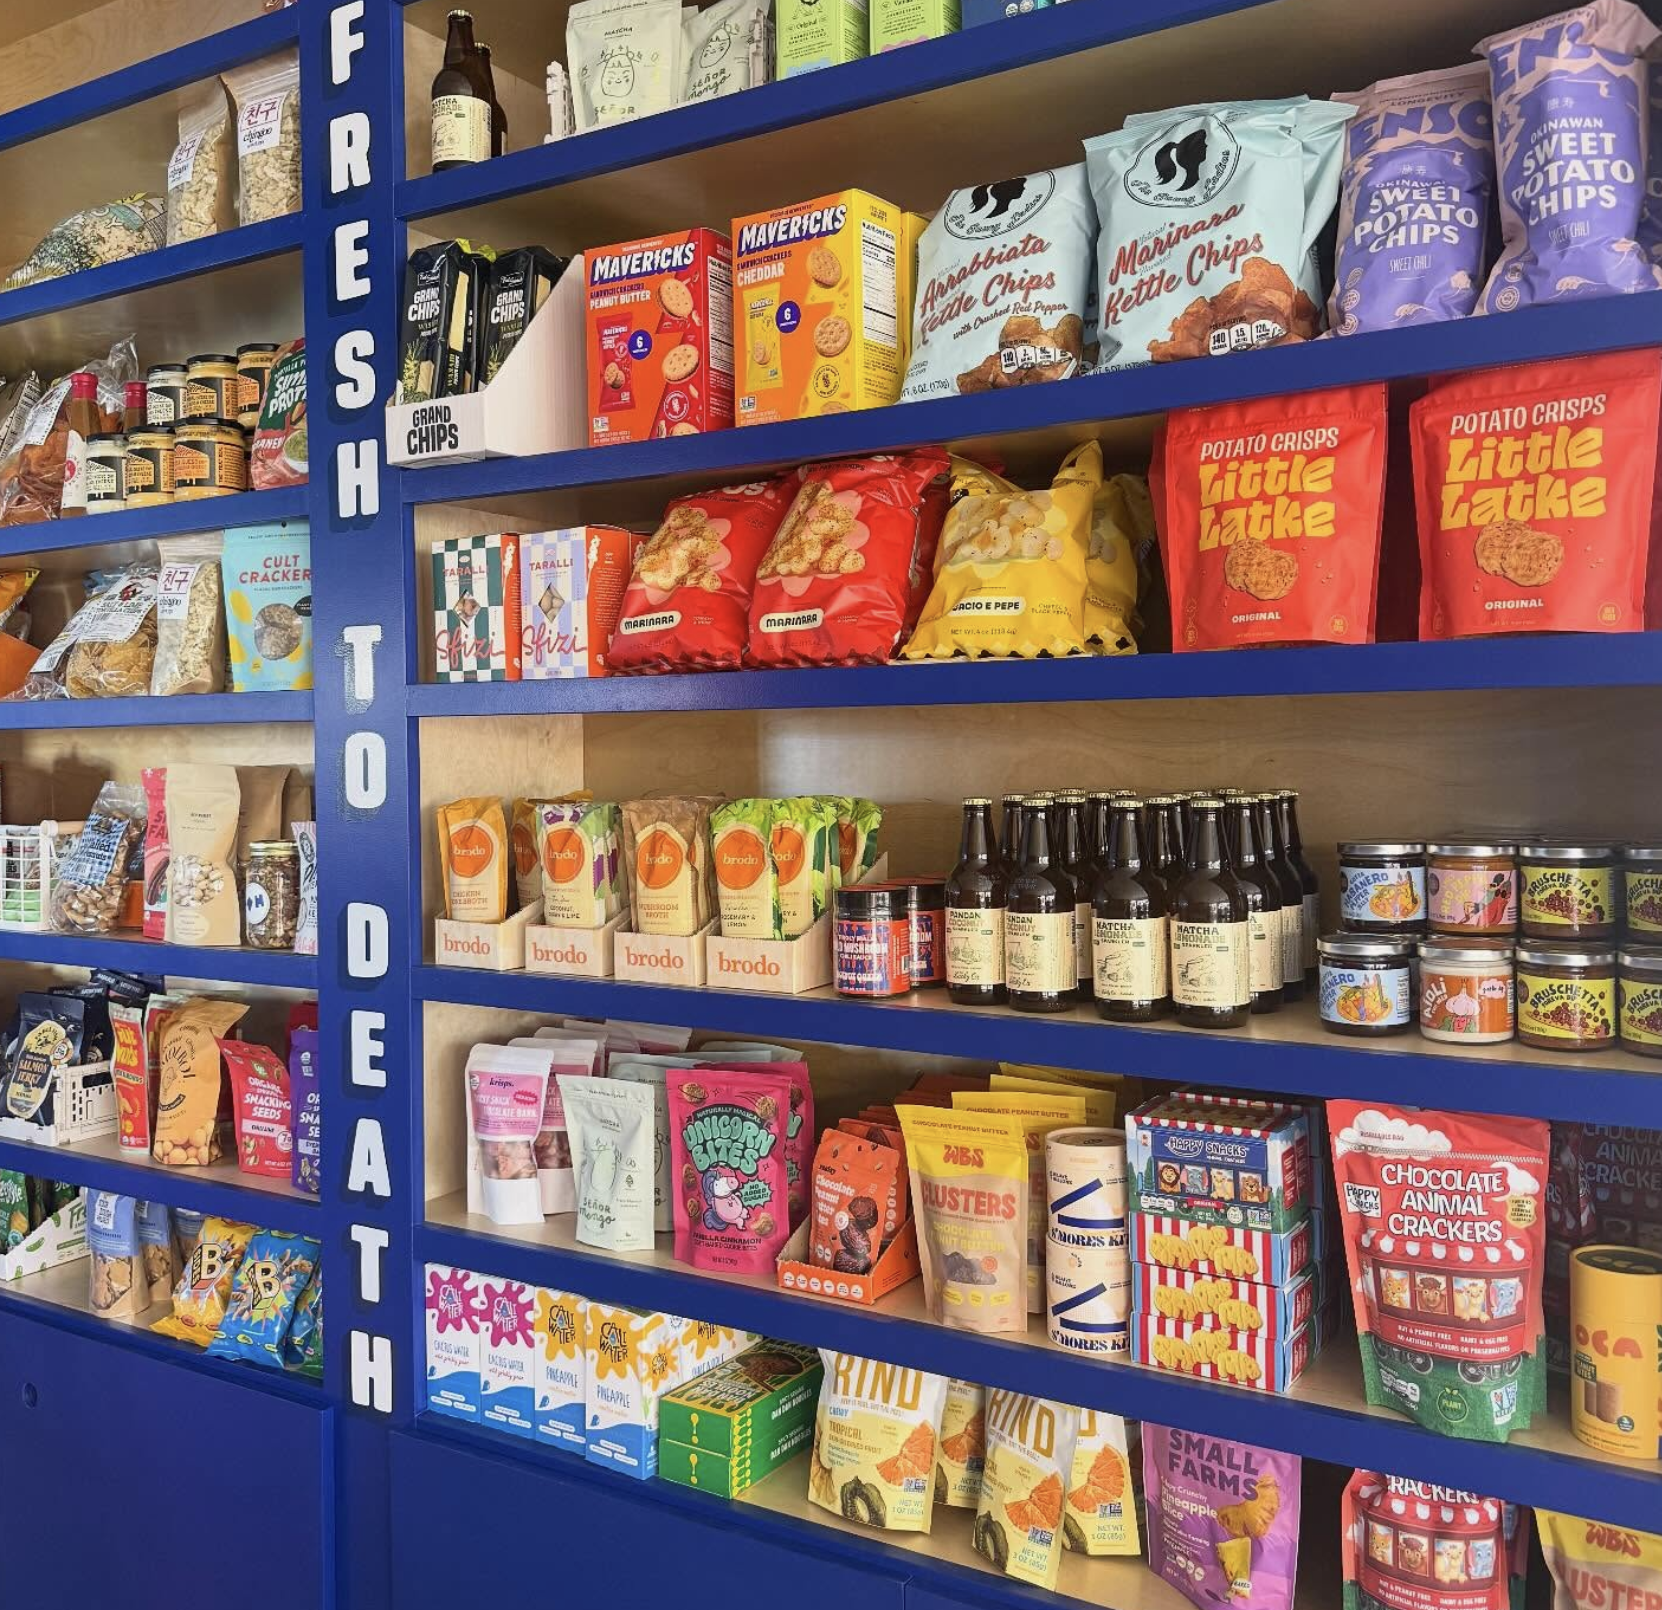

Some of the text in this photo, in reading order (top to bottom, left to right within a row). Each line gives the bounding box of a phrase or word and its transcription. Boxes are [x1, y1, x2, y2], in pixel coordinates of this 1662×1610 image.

[244, 100, 277, 126] 친구
[1530, 118, 1603, 144] OKINAWAN
[1523, 132, 1616, 176] SWEET
[1512, 159, 1635, 210] POTATO
[1369, 185, 1460, 214] SWEET
[1528, 184, 1616, 225] CHIPS
[741, 203, 848, 252] MAVERICKS
[1354, 203, 1478, 247] POTATO
[1108, 203, 1246, 286] Marinara
[1369, 223, 1459, 253] CHIPS
[592, 241, 696, 283] MAVERICKS
[737, 262, 785, 288] CHEDDAR
[919, 232, 1052, 318] Arrabbiata
[1104, 232, 1264, 330] Kettle Chips
[413, 286, 440, 304] GRAND
[496, 289, 524, 307] GRAND
[590, 289, 651, 311] PEANUT BUTTER
[919, 268, 1056, 346] Kettle Chips
[408, 299, 440, 322] CHIPS
[490, 301, 525, 325] CHIPS
[784, 307, 792, 321] 6
[1011, 299, 1032, 316] Red
[636, 335, 644, 348] 6
[412, 405, 452, 429] GRAND
[1451, 394, 1607, 436] POTATO CRISPS
[406, 423, 459, 455] CHIPS
[1201, 426, 1339, 461] POTATO CRISPS
[1446, 425, 1604, 484] Little
[1198, 455, 1336, 508] Little
[1440, 474, 1607, 532] Latke
[1198, 501, 1336, 552] Latke
[263, 554, 300, 570] CULT
[529, 558, 574, 572] TARALLI
[985, 601, 992, 610] E
[994, 601, 1020, 610] PEPE
[1484, 598, 1545, 612] ORIGINAL
[624, 613, 675, 631] MARINARA
[765, 612, 818, 628] MARINARA
[1231, 610, 1282, 625] ORIGINAL
[435, 626, 505, 668] Sfizi
[522, 621, 588, 666] Sfizi
[330, 0, 392, 1413] FRESH TO DEATH
[453, 844, 486, 857] brodo
[1344, 872, 1389, 908] HABANERO
[1528, 872, 1592, 899] BRUSCHETTA
[948, 919, 983, 927] COCONUT
[949, 910, 981, 919] PANDAN
[1096, 921, 1136, 931] MATCHA
[1176, 924, 1219, 936] MATCHA
[443, 933, 491, 956] brodo
[532, 941, 588, 965] brodo
[625, 945, 685, 970] brodo
[718, 951, 781, 976] brodo
[1530, 983, 1600, 1012] BRUSCHETTA
[243, 1092, 292, 1110] SNACKING
[252, 1106, 282, 1120] SEEDS
[696, 1106, 733, 1119] NATURALLY
[1011, 1108, 1040, 1117] PEANUT
[1041, 1110, 1070, 1119] BUTTER
[682, 1114, 776, 1157] UNICORN
[1168, 1136, 1247, 1157] HAPPY SNACKS
[691, 1137, 760, 1175] BITES
[815, 1174, 855, 1197] chocolate
[1381, 1163, 1505, 1194] CHOCOLATE
[921, 1179, 1017, 1220] CLUSTERS
[1345, 1183, 1380, 1201] HAPPY
[1400, 1189, 1489, 1217] ANIMAL
[1051, 1226, 1106, 1248] S'MORES
[1387, 1213, 1503, 1244] CRACKERS
[439, 1284, 462, 1303] CALI
[438, 1300, 464, 1320] WATER
[493, 1297, 517, 1316] CALI
[550, 1305, 574, 1327] CALI
[493, 1312, 518, 1332] WATER
[549, 1322, 576, 1344] WATER
[600, 1322, 626, 1347] CALI
[1051, 1329, 1107, 1351] S'MORES
[453, 1343, 470, 1358] WATER
[600, 1339, 628, 1364] WATER
[506, 1358, 524, 1373] WATER
[545, 1366, 579, 1389] PINEAPPLE
[596, 1385, 631, 1410] PINEAPPLE
[829, 1420, 863, 1441] TROPICAL
[1169, 1428, 1260, 1476] SMALL
[1168, 1451, 1259, 1502] FARMS
[1161, 1485, 1218, 1519] Pineapple
